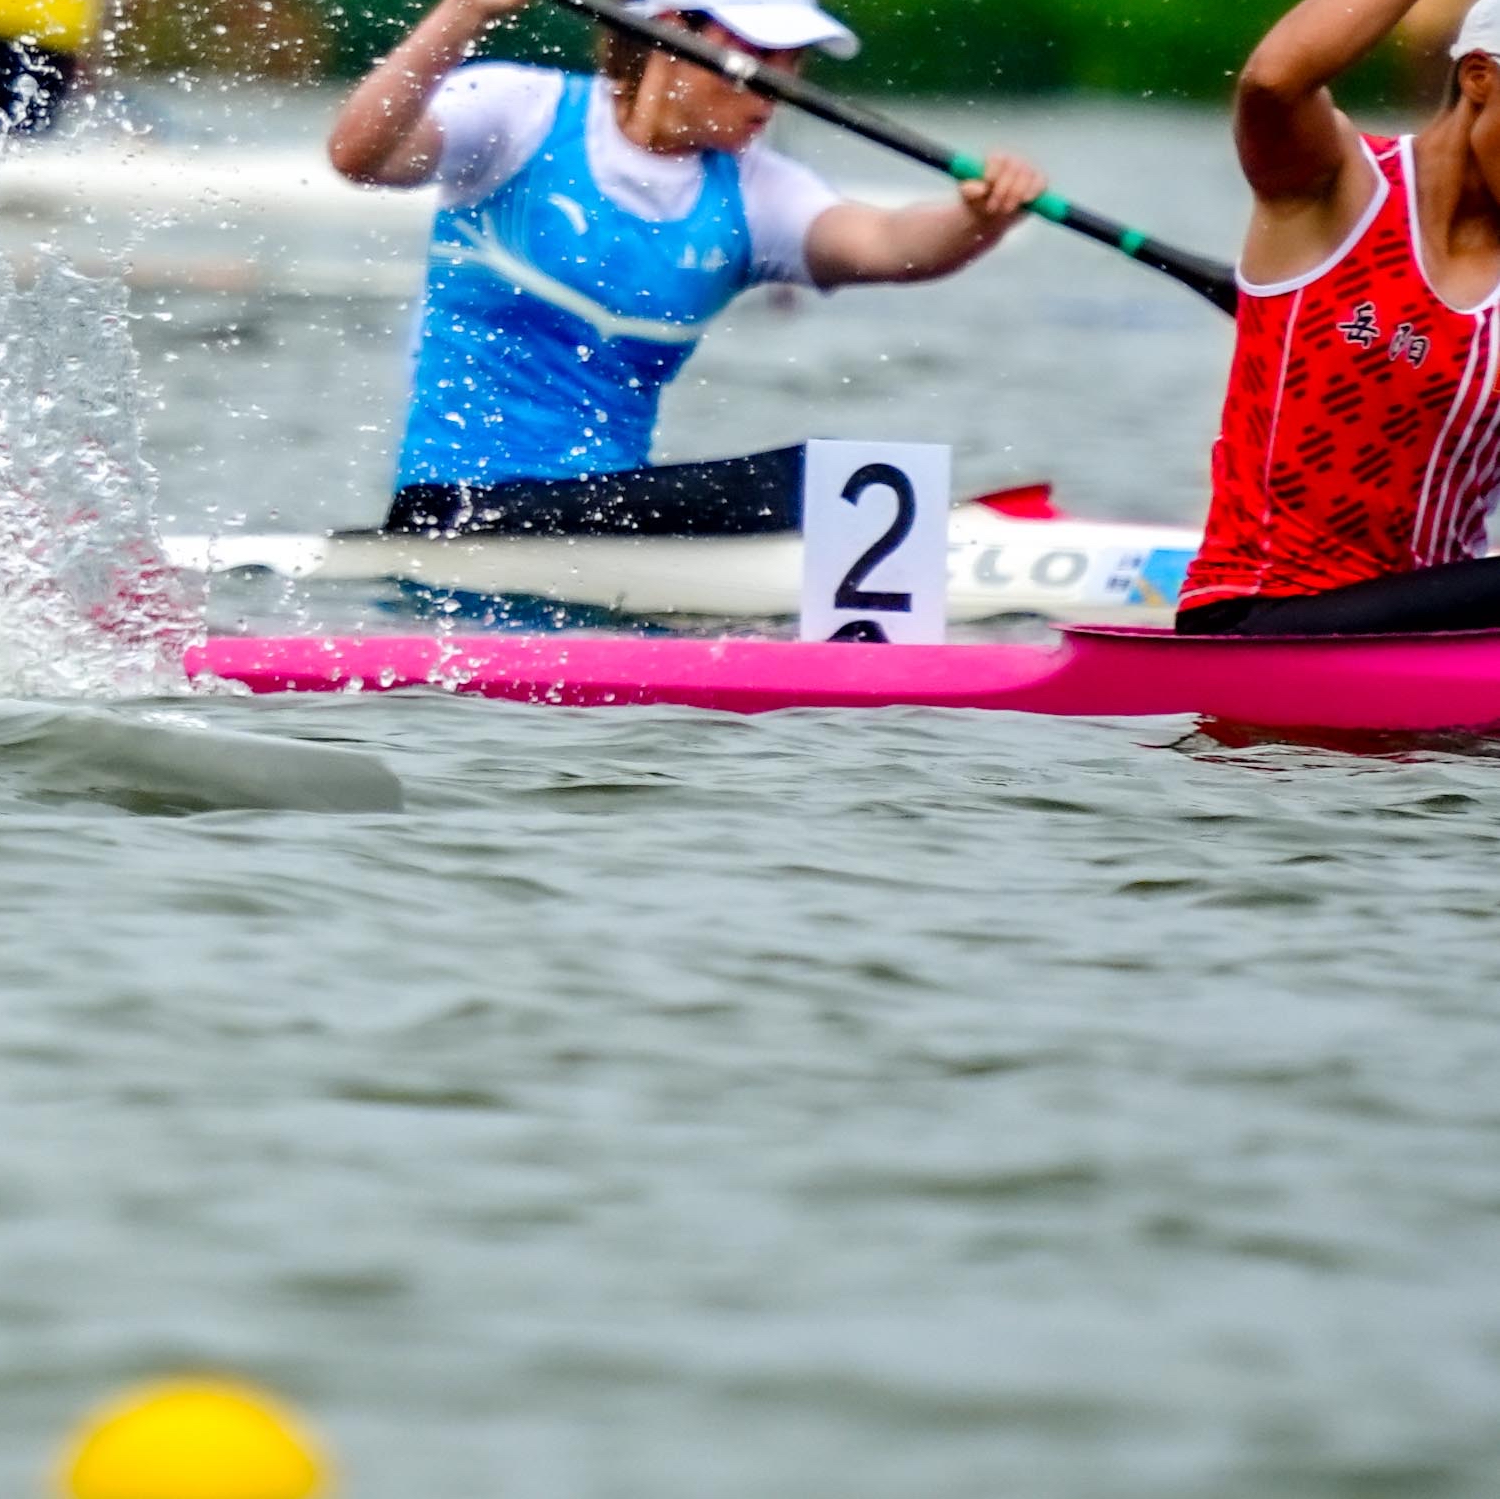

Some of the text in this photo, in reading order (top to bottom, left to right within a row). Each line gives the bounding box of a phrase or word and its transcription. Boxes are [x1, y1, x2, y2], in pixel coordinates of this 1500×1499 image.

[1336, 301, 1430, 370] 岳阳
[834, 462, 917, 613] 2
[948, 543, 1090, 588] LO
